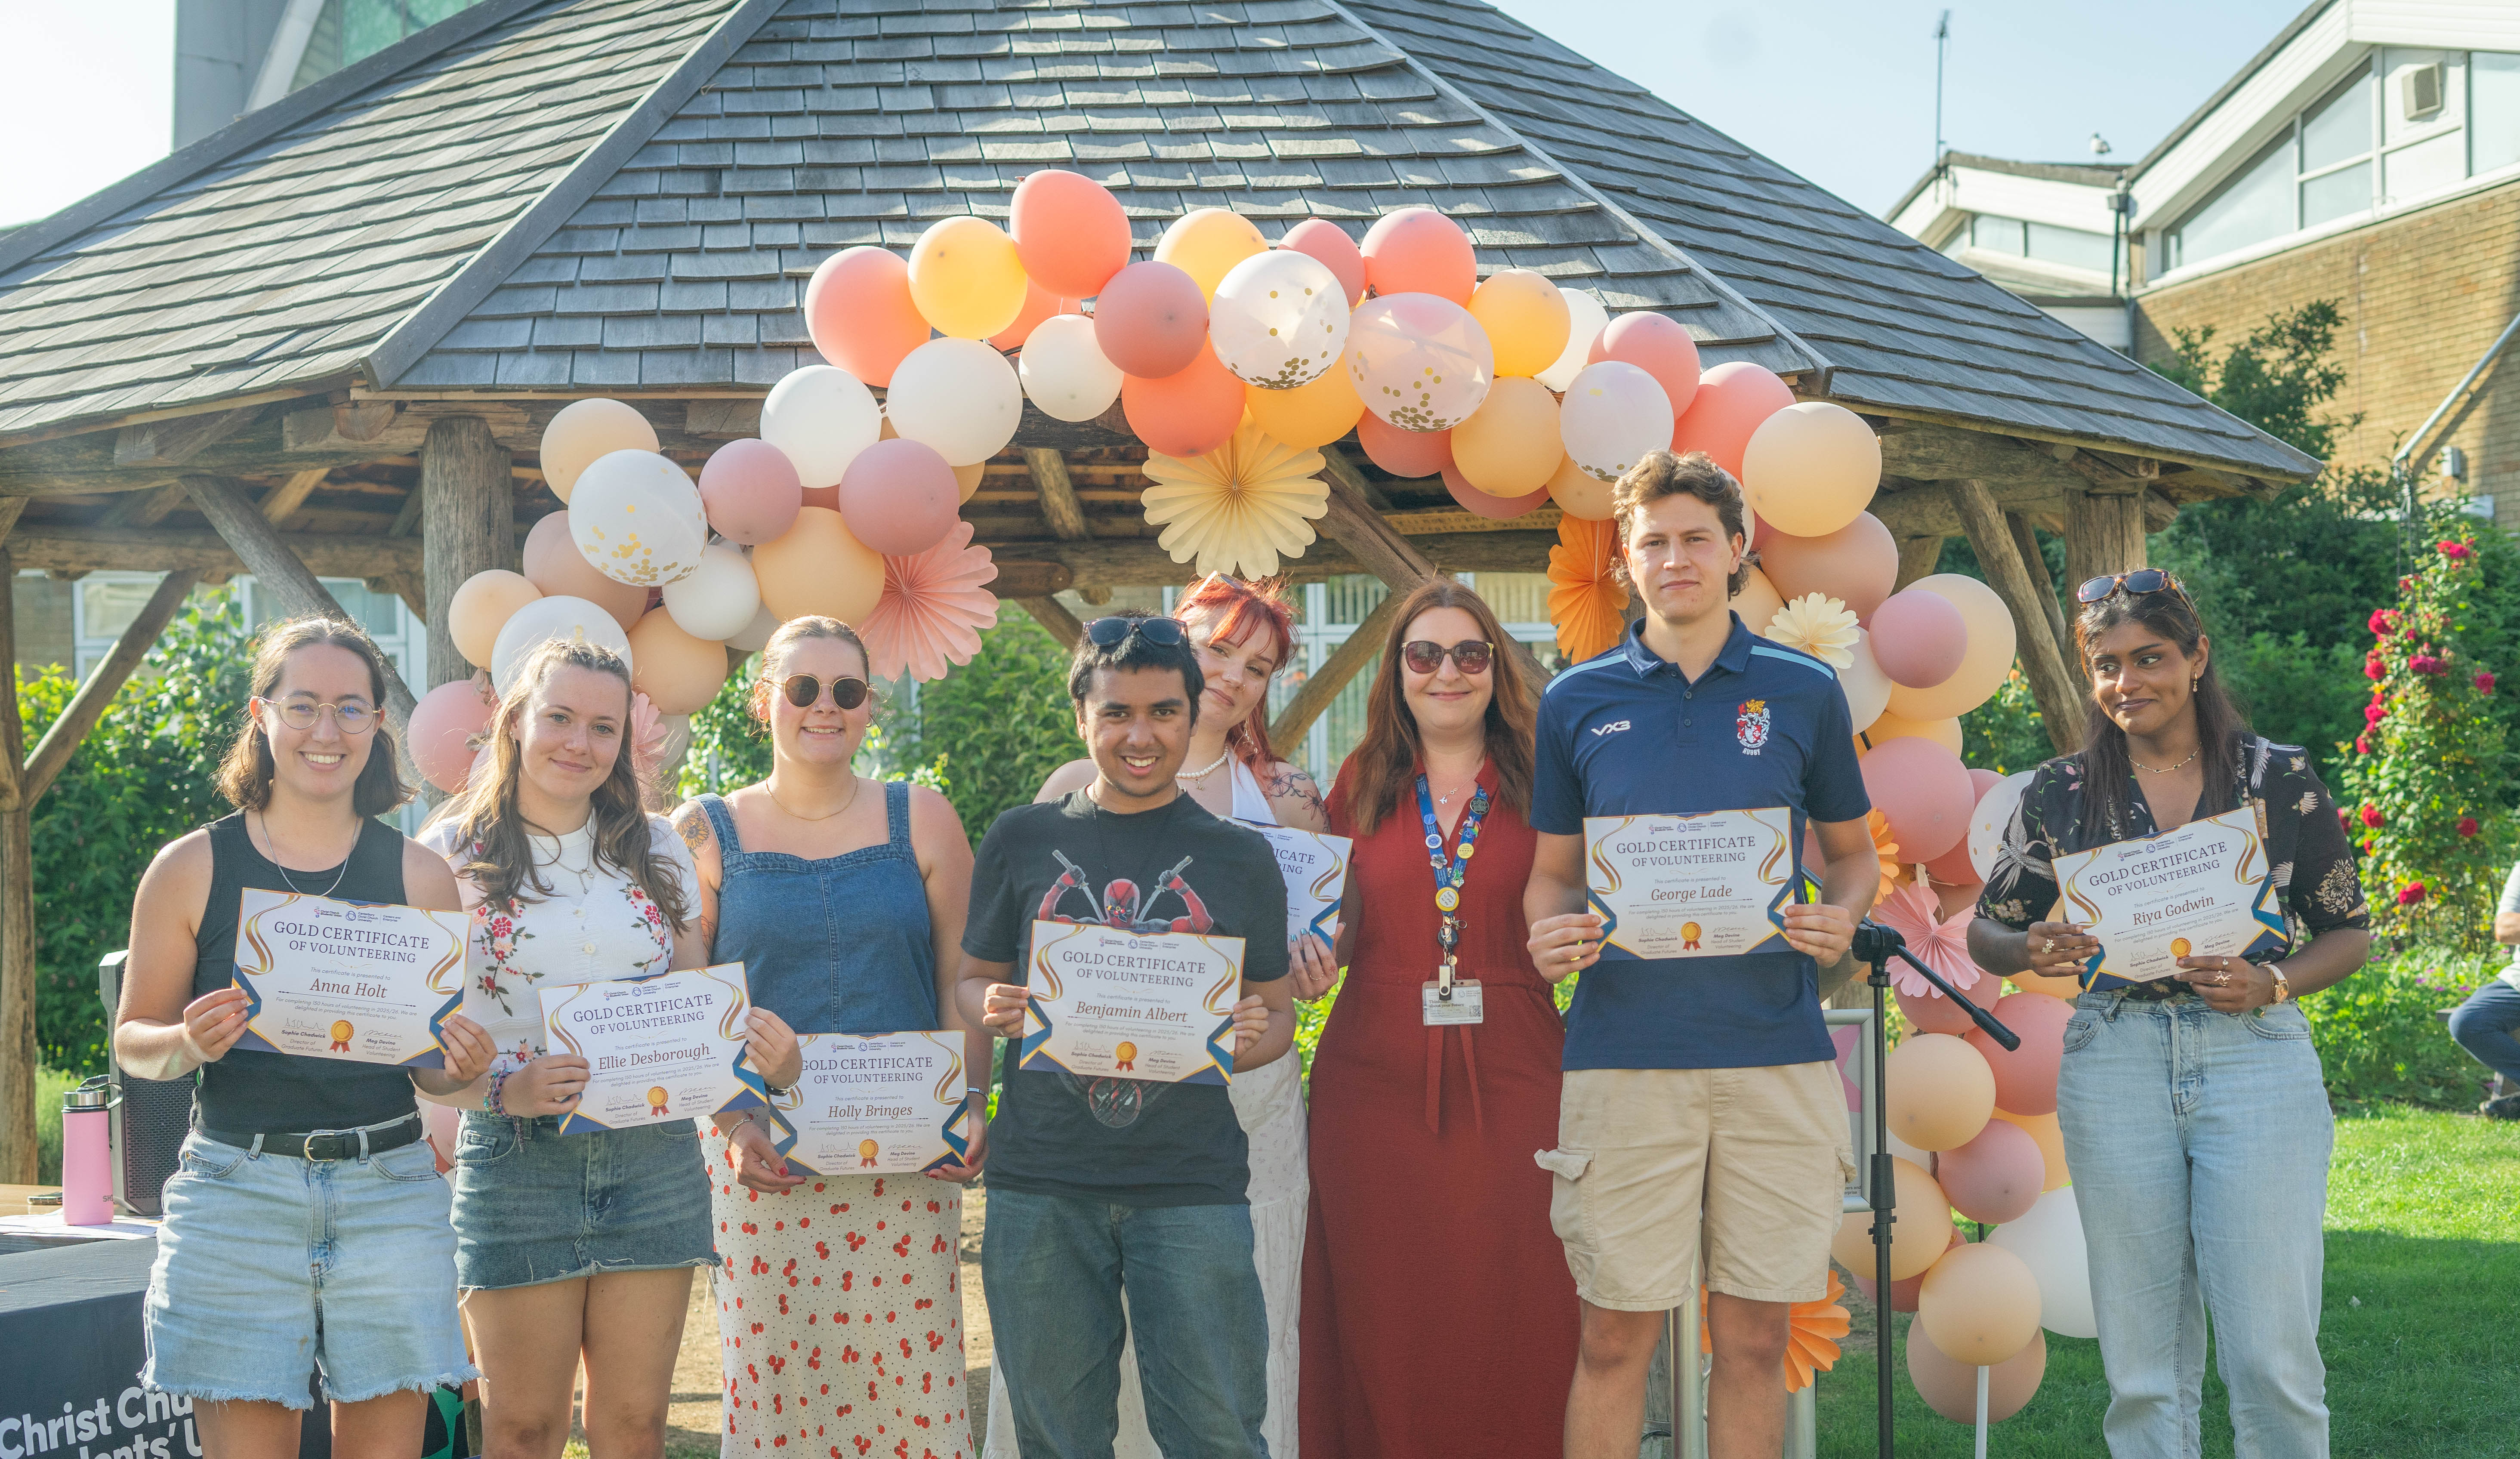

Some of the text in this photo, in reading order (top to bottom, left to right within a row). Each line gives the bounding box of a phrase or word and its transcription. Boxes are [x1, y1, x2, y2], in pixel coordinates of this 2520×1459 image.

[1591, 720, 1630, 736] VX3
[1616, 836, 1755, 854] GOLD CERTIFICATE
[1632, 852, 1745, 867] OF VOLUNTEERING
[2089, 841, 2227, 886] GOLD CERTIFICATE
[2107, 859, 2220, 896] OF VOLUNTEERING
[1651, 885, 1732, 903] George Lade
[2144, 896, 2168, 906] certificate
[2174, 887, 2199, 899] presented
[2132, 895, 2215, 926] Riya Godwin
[274, 921, 429, 949] GOLD CERTIFICATE
[289, 940, 416, 963] OF VOLUNTEERING
[1063, 950, 1205, 973] GOLD CERTIFICATE
[1076, 968, 1193, 987] OF VOLUNTEERING
[309, 978, 388, 998] Anna Holt
[284, 997, 311, 1006] completing
[341, 1004, 370, 1012] volunteering
[573, 994, 713, 1022] GOLD CERTIFICATE
[1075, 1001, 1188, 1022] Benjamin Albert
[590, 1011, 704, 1034] OF VOLUNTEERING
[656, 1037, 681, 1046] presented
[366, 1050, 395, 1058] Volunteering
[598, 1043, 709, 1070] Ellie Desborough
[802, 1057, 932, 1070] GOLD CERTIFICATE
[636, 1077, 656, 1085] providing
[651, 1069, 676, 1077] volunteering
[814, 1072, 922, 1084] OF VOLUNTEERING
[827, 1104, 912, 1120] Holly Bringes
[0, 1397, 111, 1459] Christ
[117, 1386, 193, 1428] Chu
